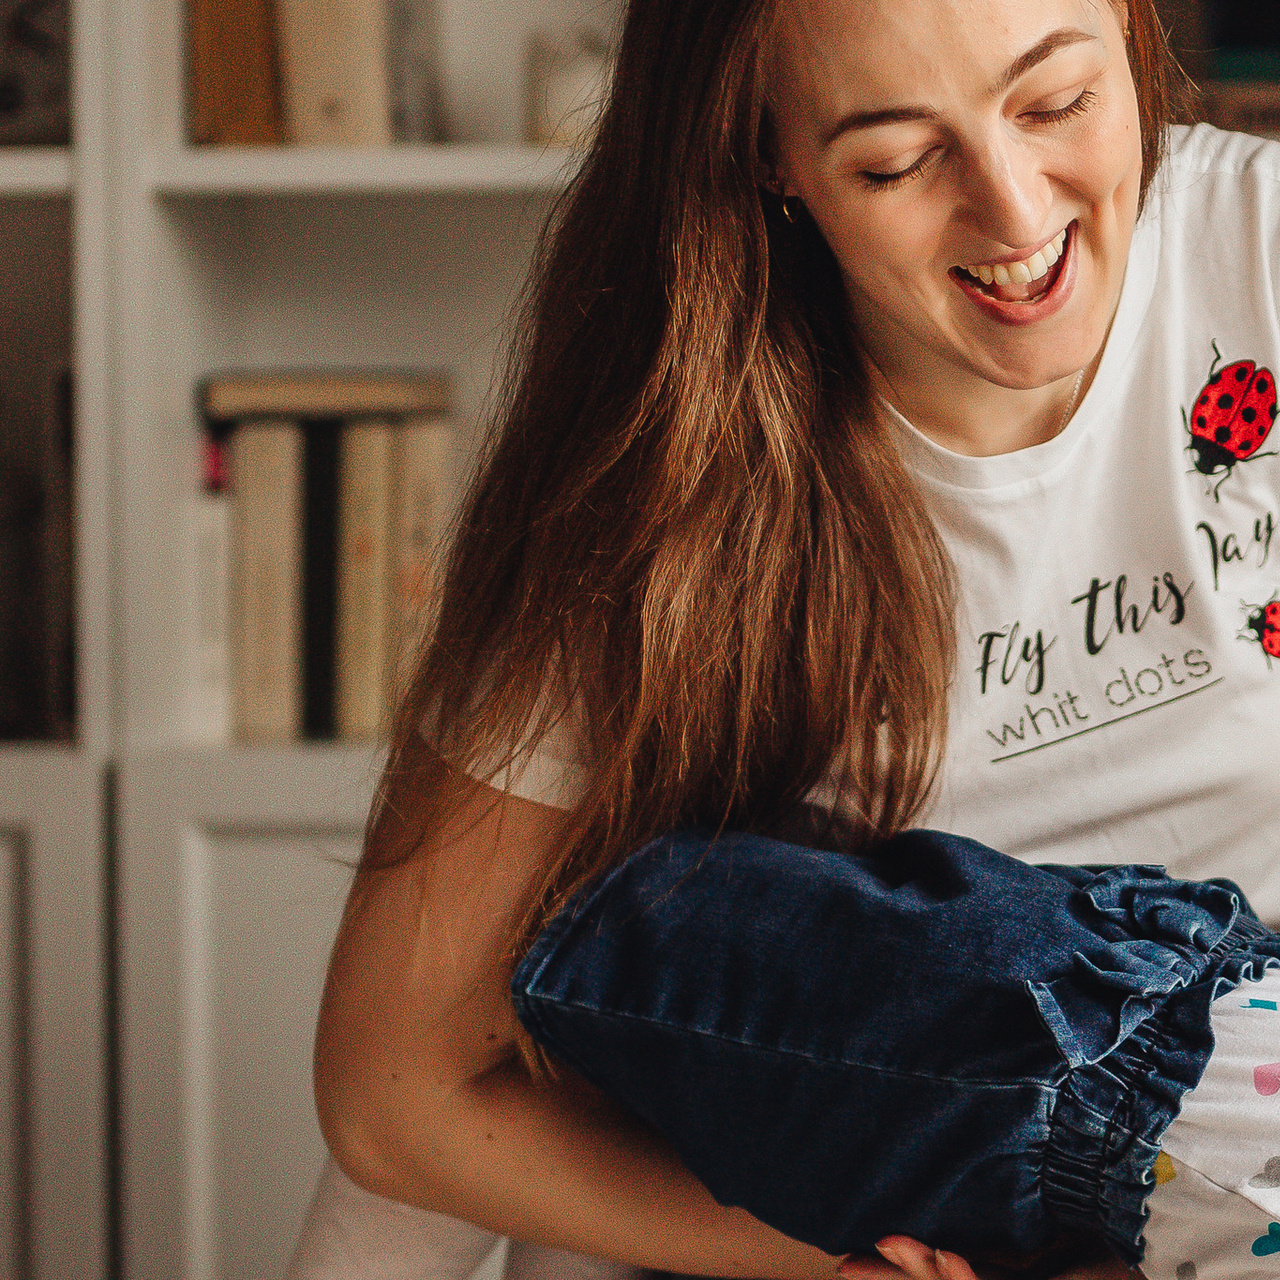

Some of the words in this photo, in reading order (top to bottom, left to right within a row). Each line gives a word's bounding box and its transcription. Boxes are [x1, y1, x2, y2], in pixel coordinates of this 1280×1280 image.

[975, 620, 1057, 695] Fly
[1070, 572, 1194, 655] this
[986, 690, 1089, 747] whit
[1105, 649, 1212, 707] dots
